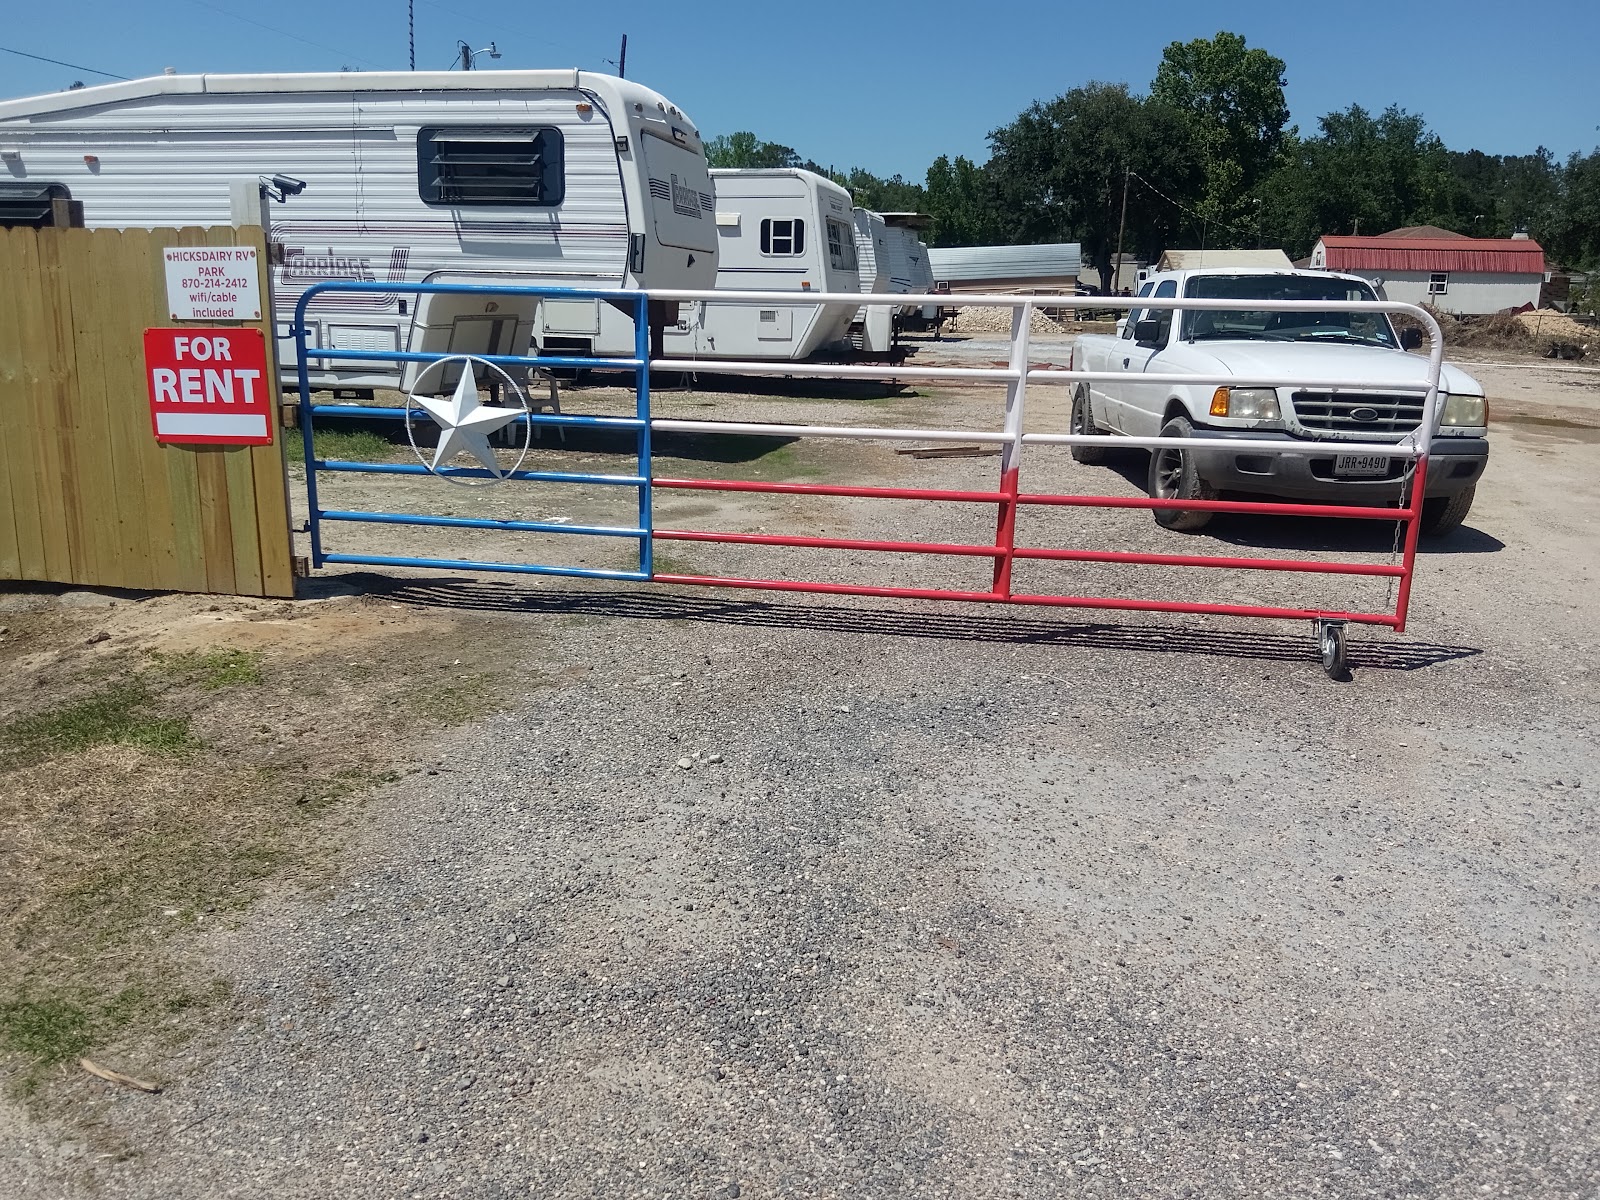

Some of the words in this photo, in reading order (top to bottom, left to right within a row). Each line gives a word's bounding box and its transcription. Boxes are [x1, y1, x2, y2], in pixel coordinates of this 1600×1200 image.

[172, 251, 233, 262] HICKSDAIRY
[235, 251, 249, 261] RV
[198, 267, 226, 277] PARK
[182, 278, 248, 289] 870-214-2412
[189, 291, 238, 303] wifi/cable
[192, 307, 235, 318] included
[174, 336, 232, 361] FOR
[153, 368, 261, 404] RENT
